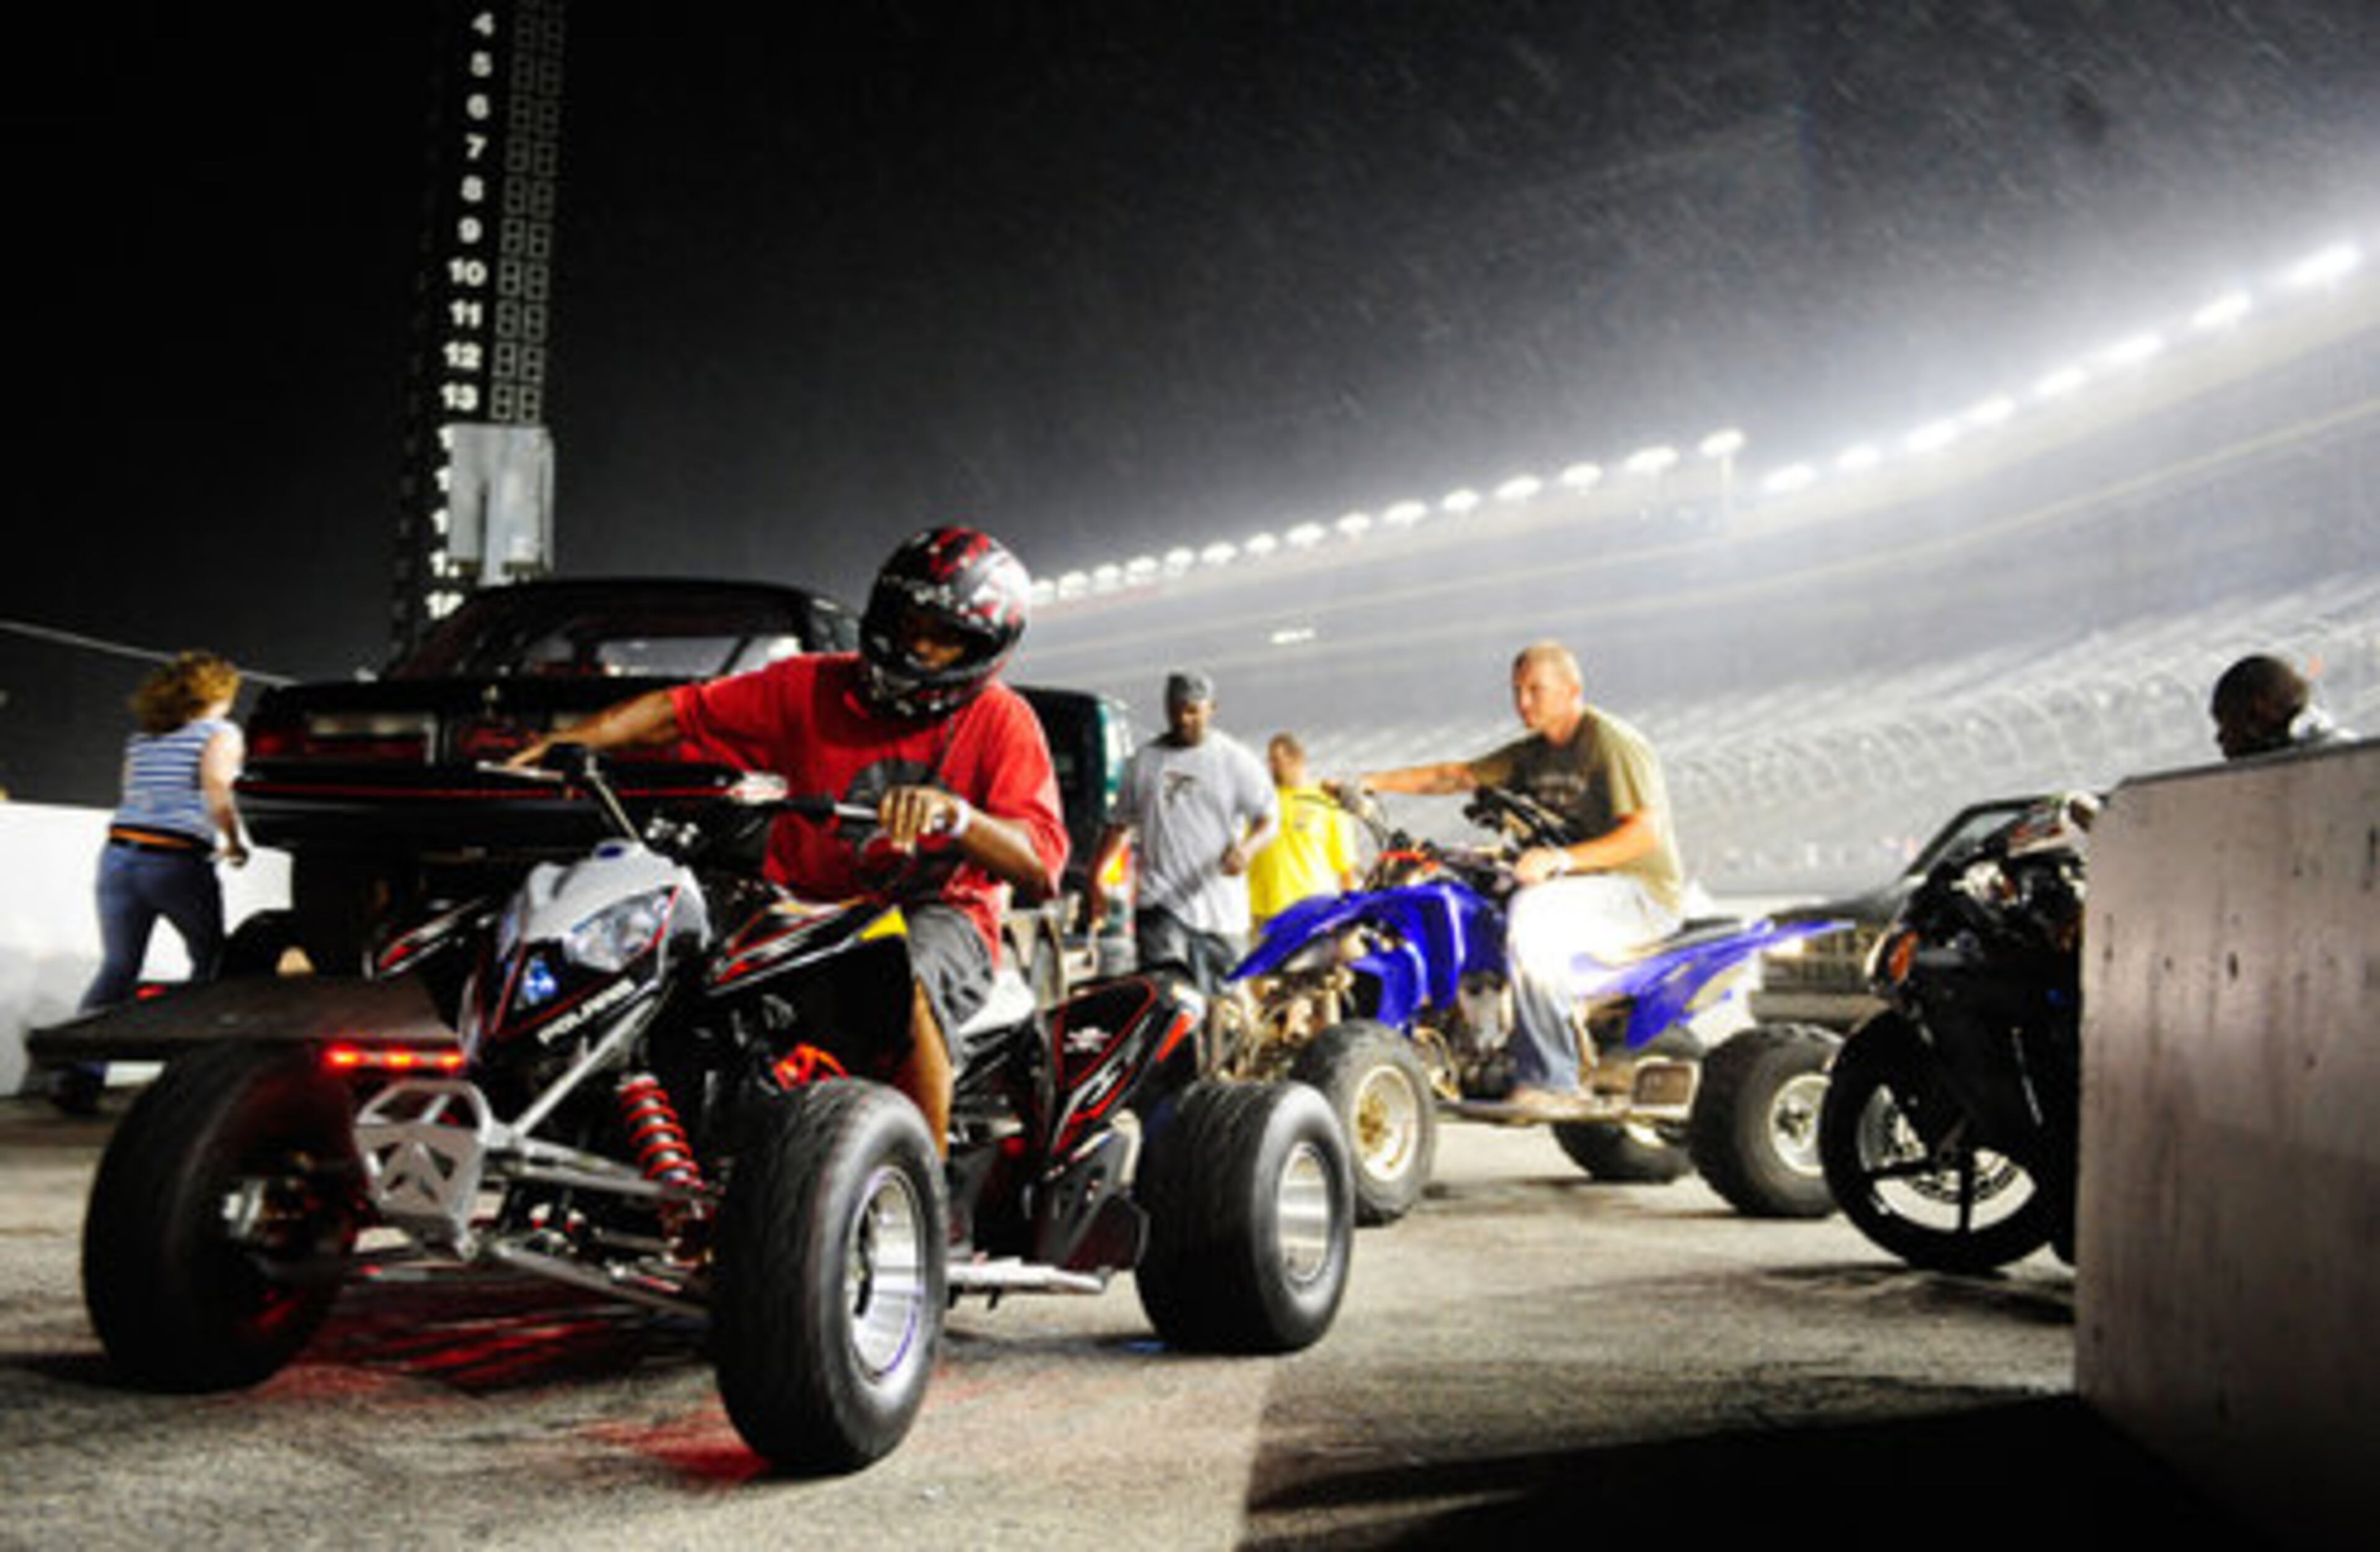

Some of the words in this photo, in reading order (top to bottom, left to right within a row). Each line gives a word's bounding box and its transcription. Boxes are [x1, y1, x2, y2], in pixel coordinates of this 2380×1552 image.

[472, 12, 494, 35] 4
[471, 51, 492, 77] 5
[467, 94, 490, 120] 6
[466, 133, 487, 159] 7
[461, 175, 484, 201] 8
[458, 216, 482, 244] 9
[448, 257, 488, 287] 10
[449, 299, 483, 328] 11
[443, 340, 483, 371] 12
[440, 381, 479, 412] 13
[537, 976, 635, 1045] POLARIS
